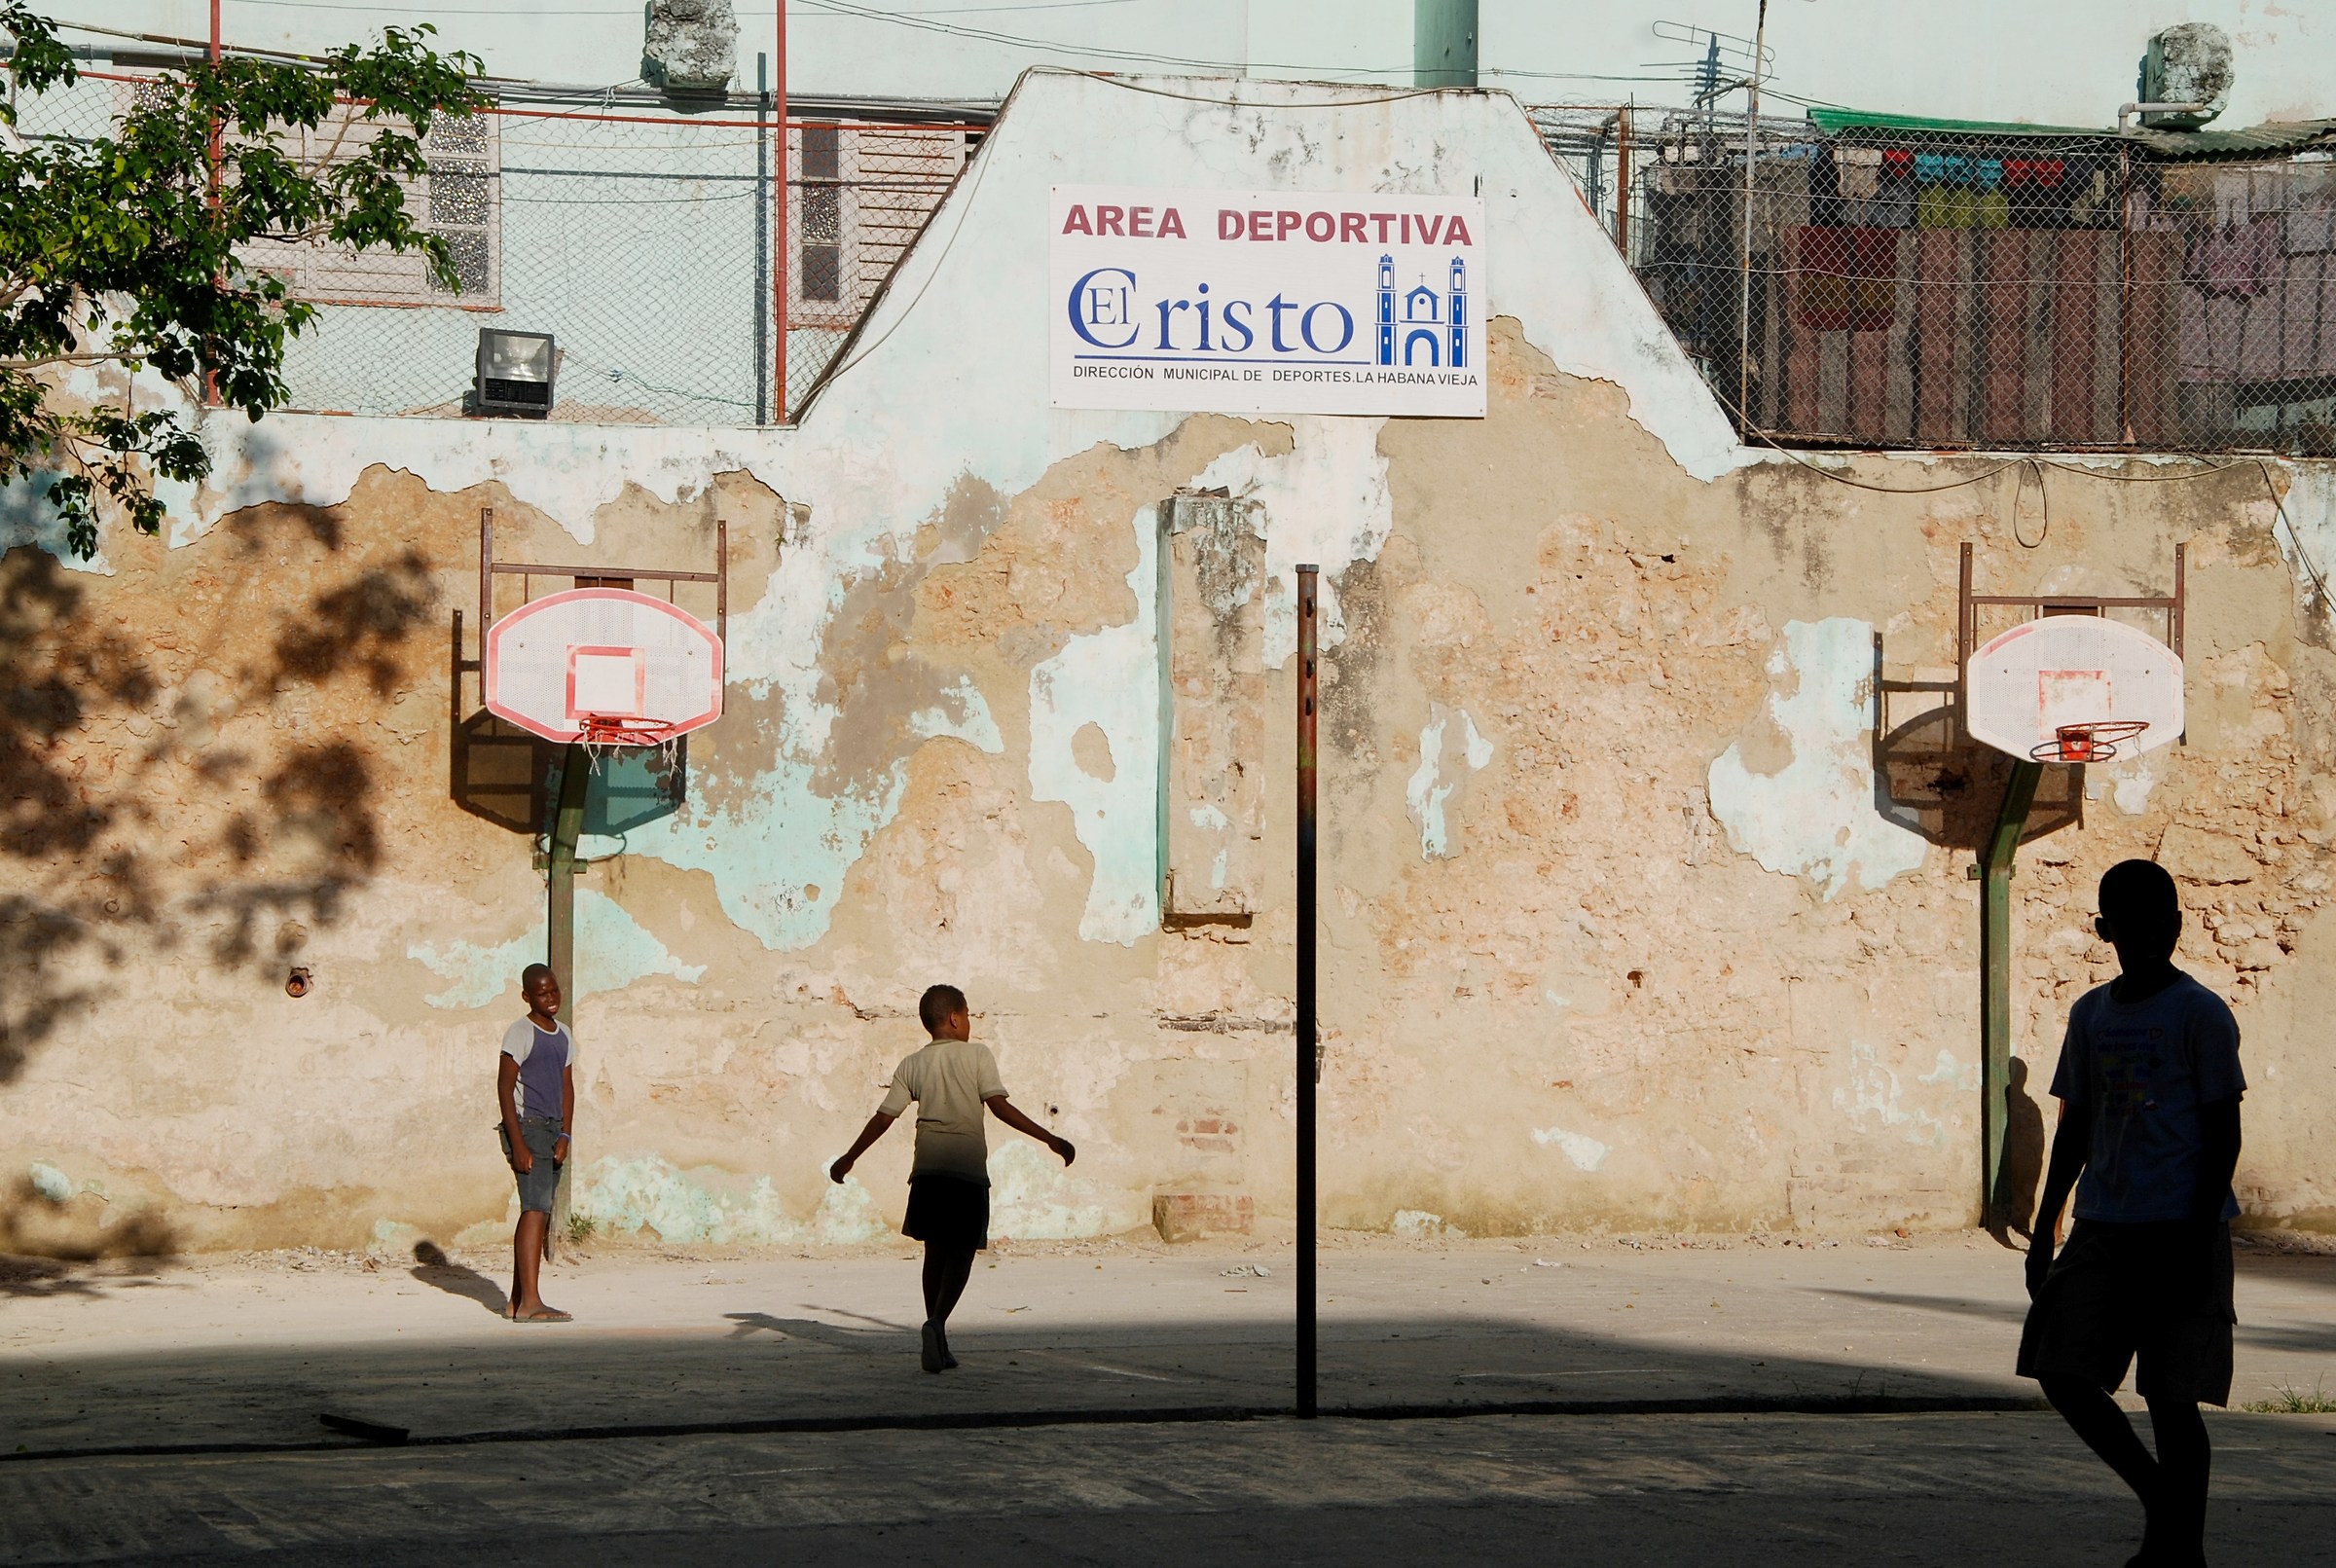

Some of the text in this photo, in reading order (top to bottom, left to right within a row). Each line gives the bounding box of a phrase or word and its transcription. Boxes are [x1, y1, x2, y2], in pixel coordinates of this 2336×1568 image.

[1062, 204, 1473, 246] AREA DEPORTIVA
[1068, 268, 1354, 353] El Cristo
[1074, 364, 1154, 380] DIRECCIÓN
[1163, 368, 1239, 382] MUNICIPAL
[1243, 370, 1262, 382] DE
[1377, 373, 1436, 384] HABANA
[1439, 373, 1478, 385] VIEJA
